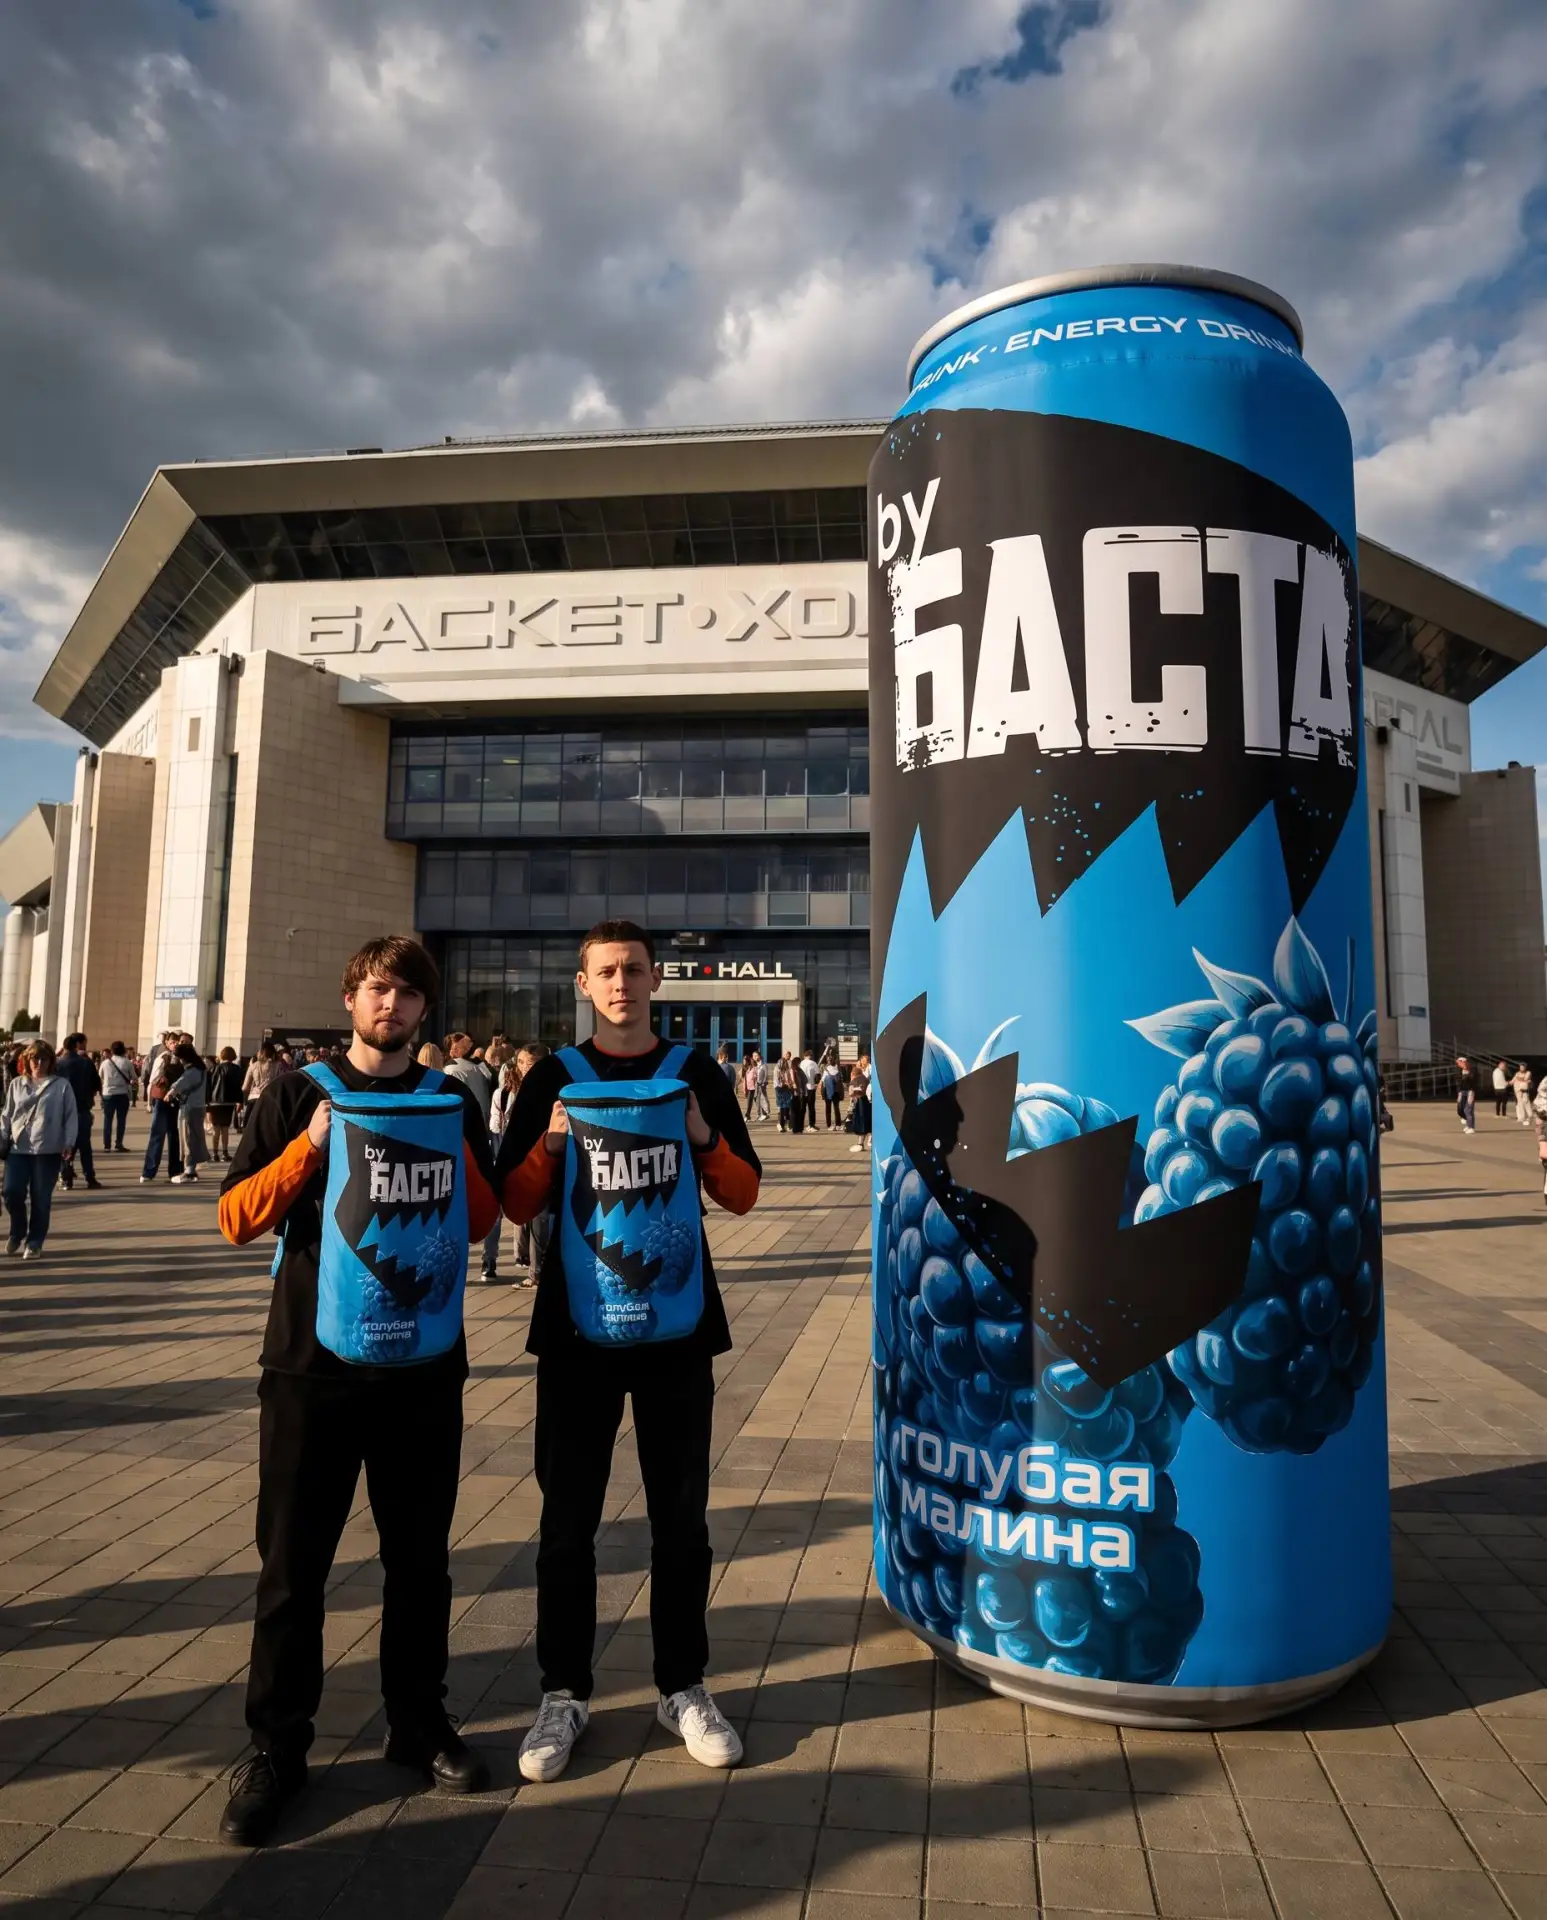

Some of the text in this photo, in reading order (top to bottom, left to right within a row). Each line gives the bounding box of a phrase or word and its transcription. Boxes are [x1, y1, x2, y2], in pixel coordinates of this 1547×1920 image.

[1004, 316, 1188, 354] ENERGY
[877, 477, 941, 568] by
[298, 586, 868, 656] БАСКЕТ ХО
[888, 526, 1356, 773] БАСТА
[653, 962, 793, 979] ET HALL
[364, 1144, 386, 1162] by
[583, 1135, 604, 1153] by
[588, 1143, 678, 1191] БАСТА
[369, 1159, 453, 1203] БАСТА
[901, 1424, 1150, 1508] голубая
[901, 1478, 1131, 1568] малина
